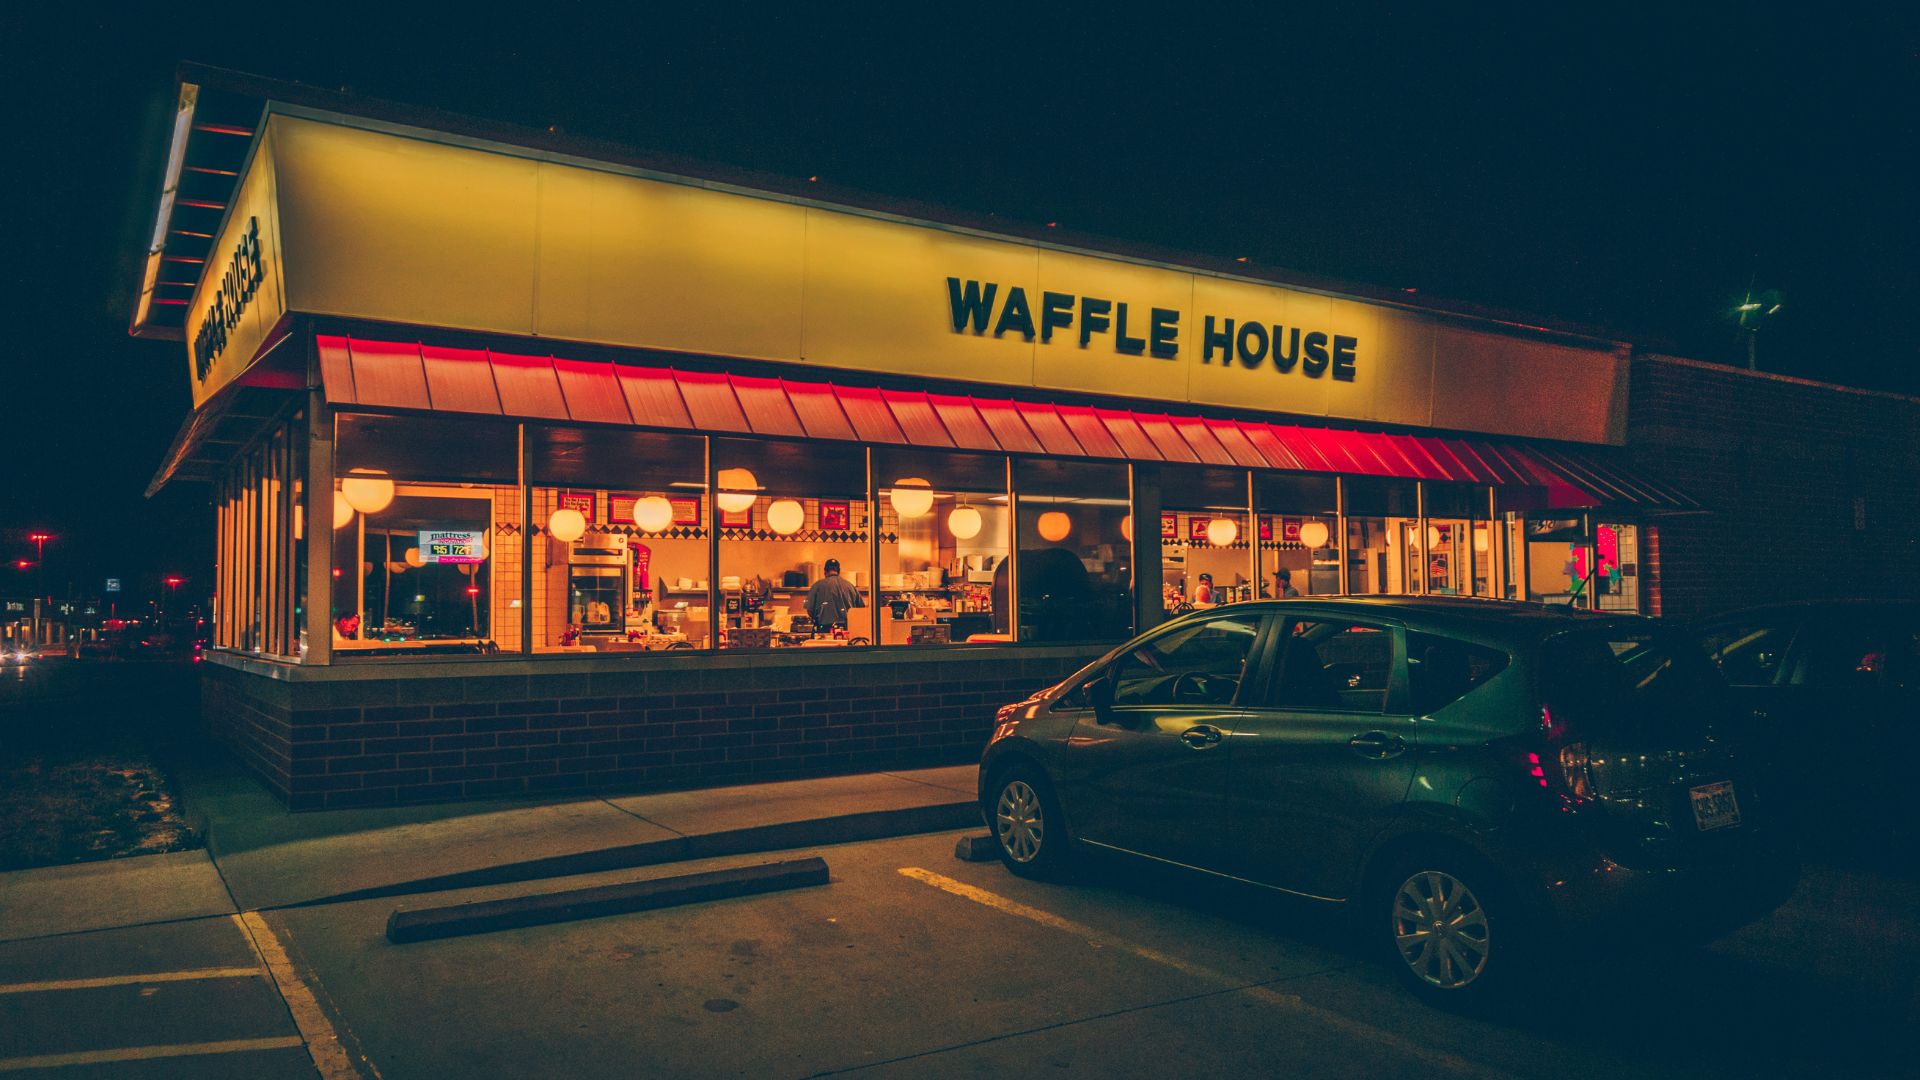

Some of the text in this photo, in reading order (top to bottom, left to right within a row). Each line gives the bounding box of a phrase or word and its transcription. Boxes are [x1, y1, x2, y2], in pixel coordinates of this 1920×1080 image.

[222, 216, 263, 333] HOUSE
[947, 277, 1358, 380] WAFFLE HOUSE
[431, 532, 471, 540] mattress
